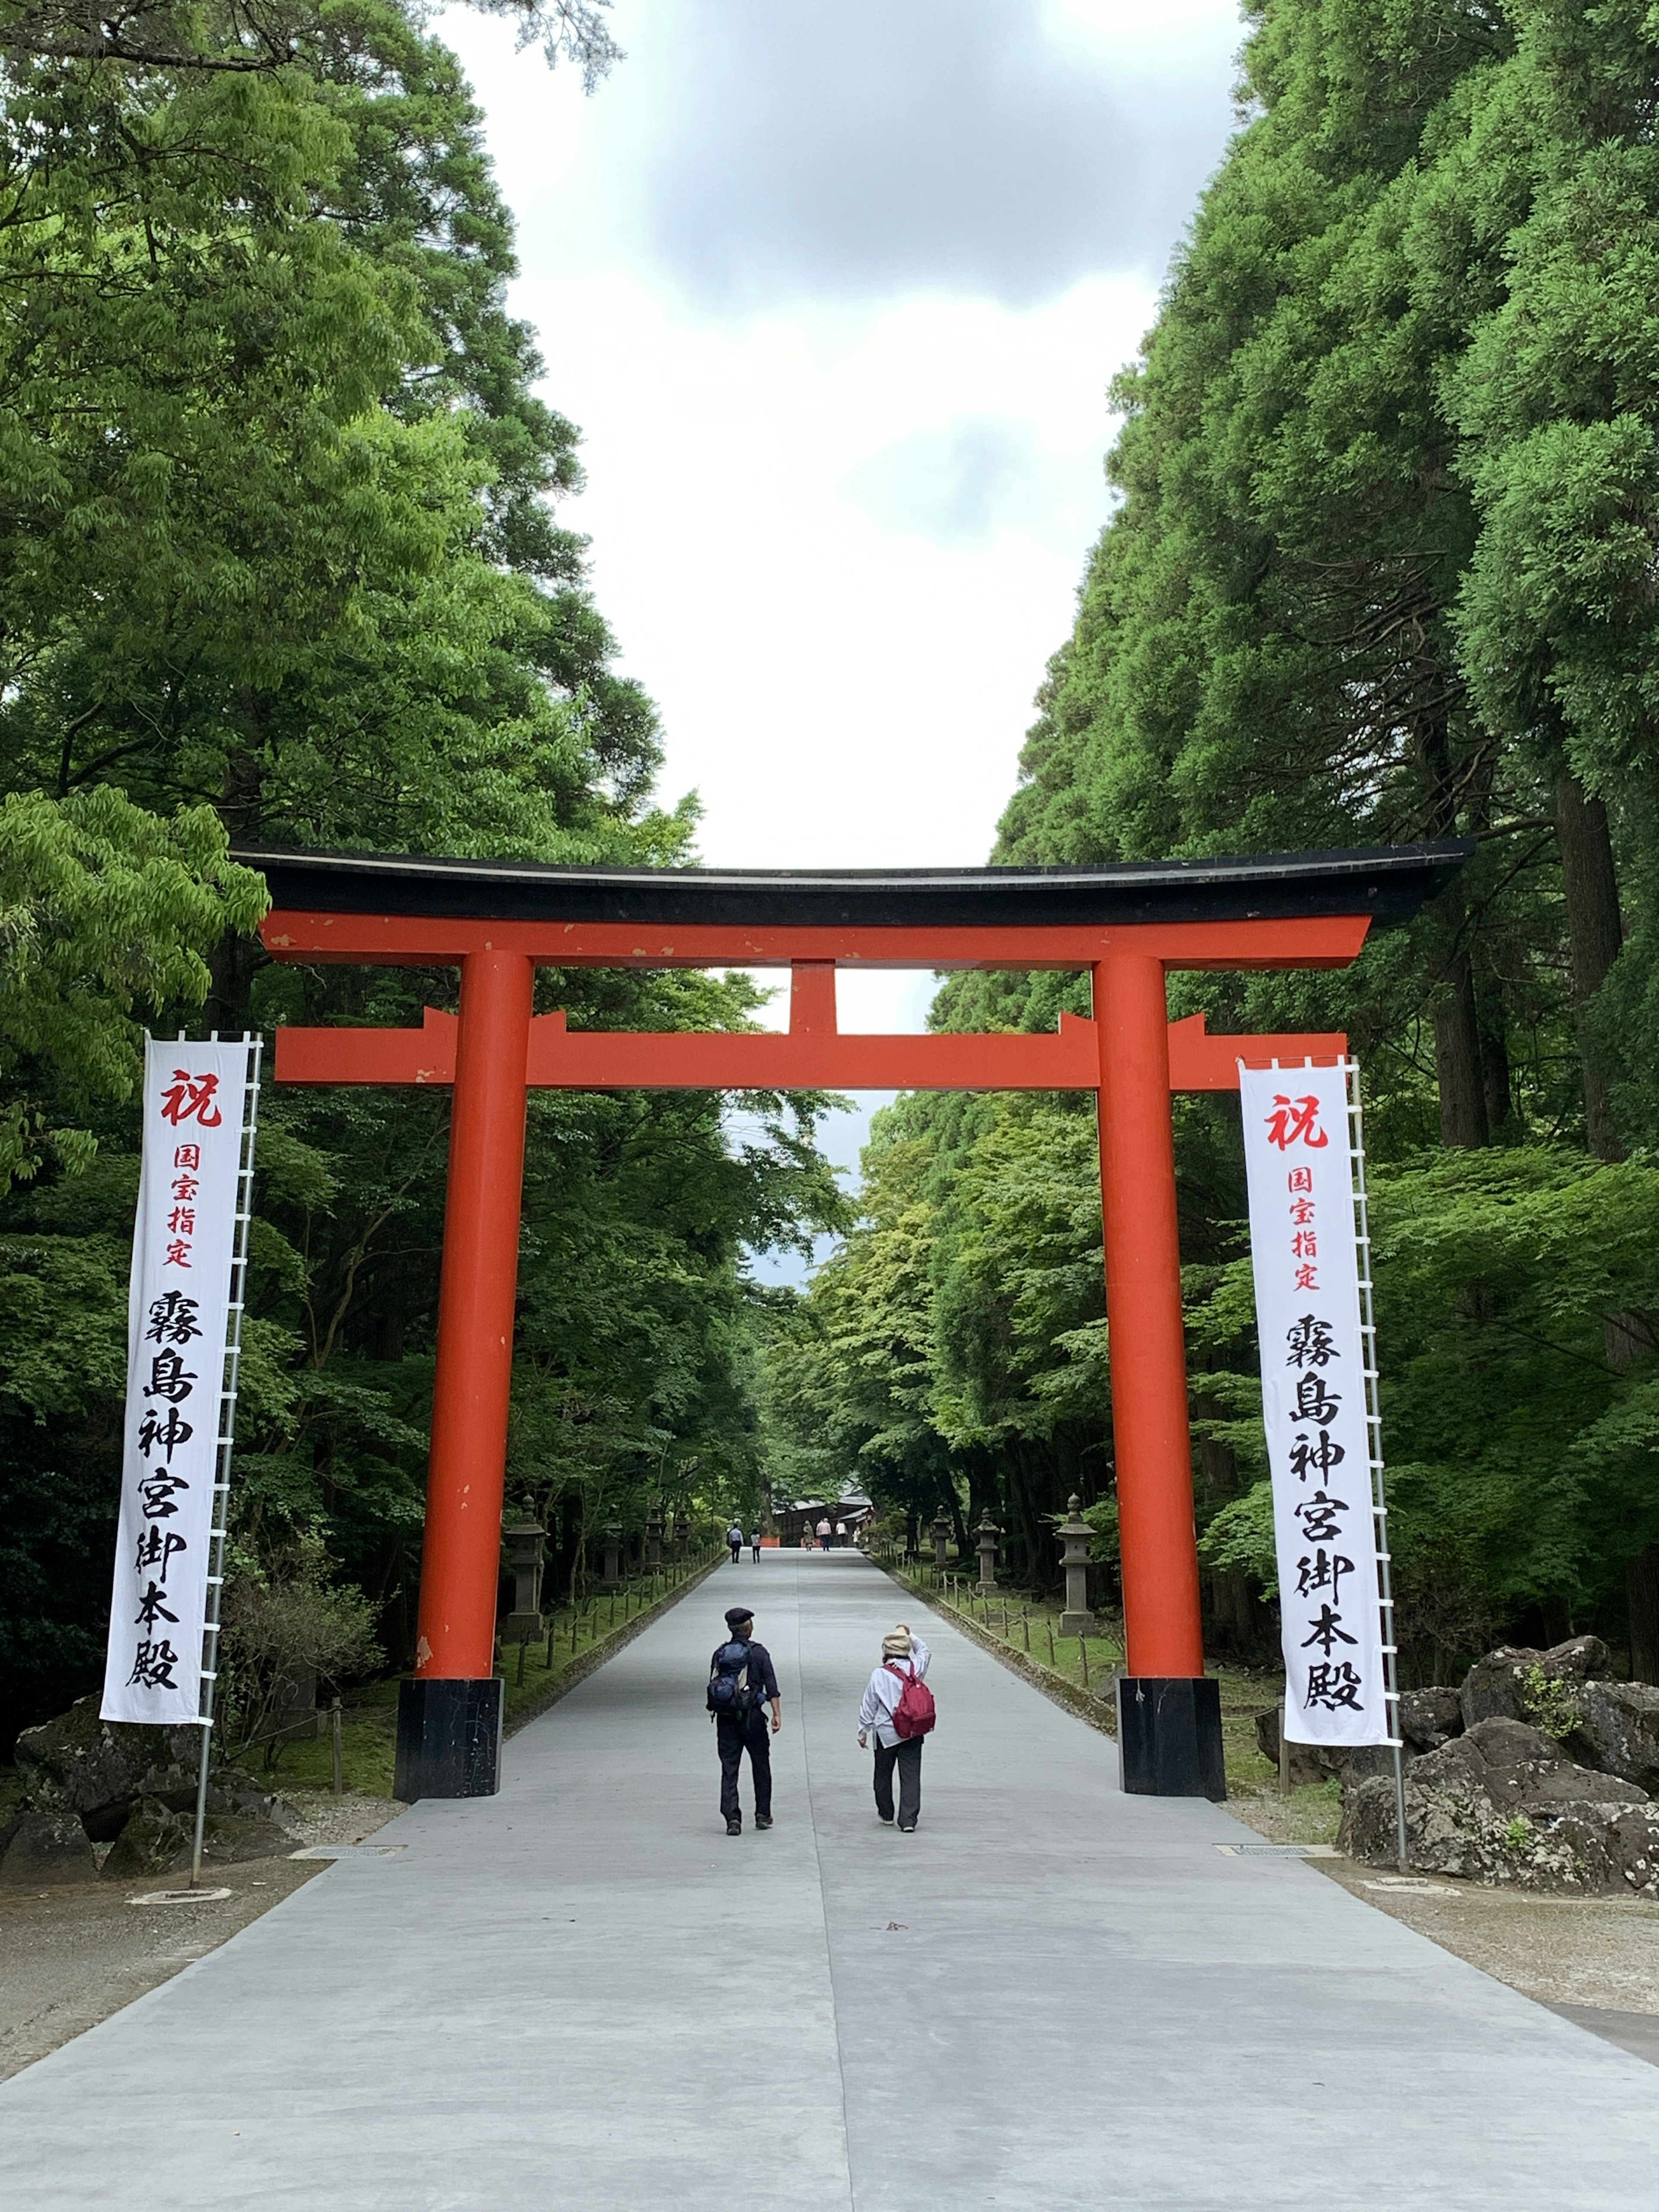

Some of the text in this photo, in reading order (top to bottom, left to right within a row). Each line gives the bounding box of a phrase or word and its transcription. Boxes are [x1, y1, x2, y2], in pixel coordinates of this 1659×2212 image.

[161, 1070, 221, 1127] 祝
[1264, 1094, 1328, 1151] 祝
[162, 1144, 199, 1268] 国宝指定
[1289, 1167, 1320, 1291] 国宝指定
[126, 1290, 203, 1690] 霧島神宮御本殿
[1285, 1313, 1364, 1711] 霧島神宮御本殿
